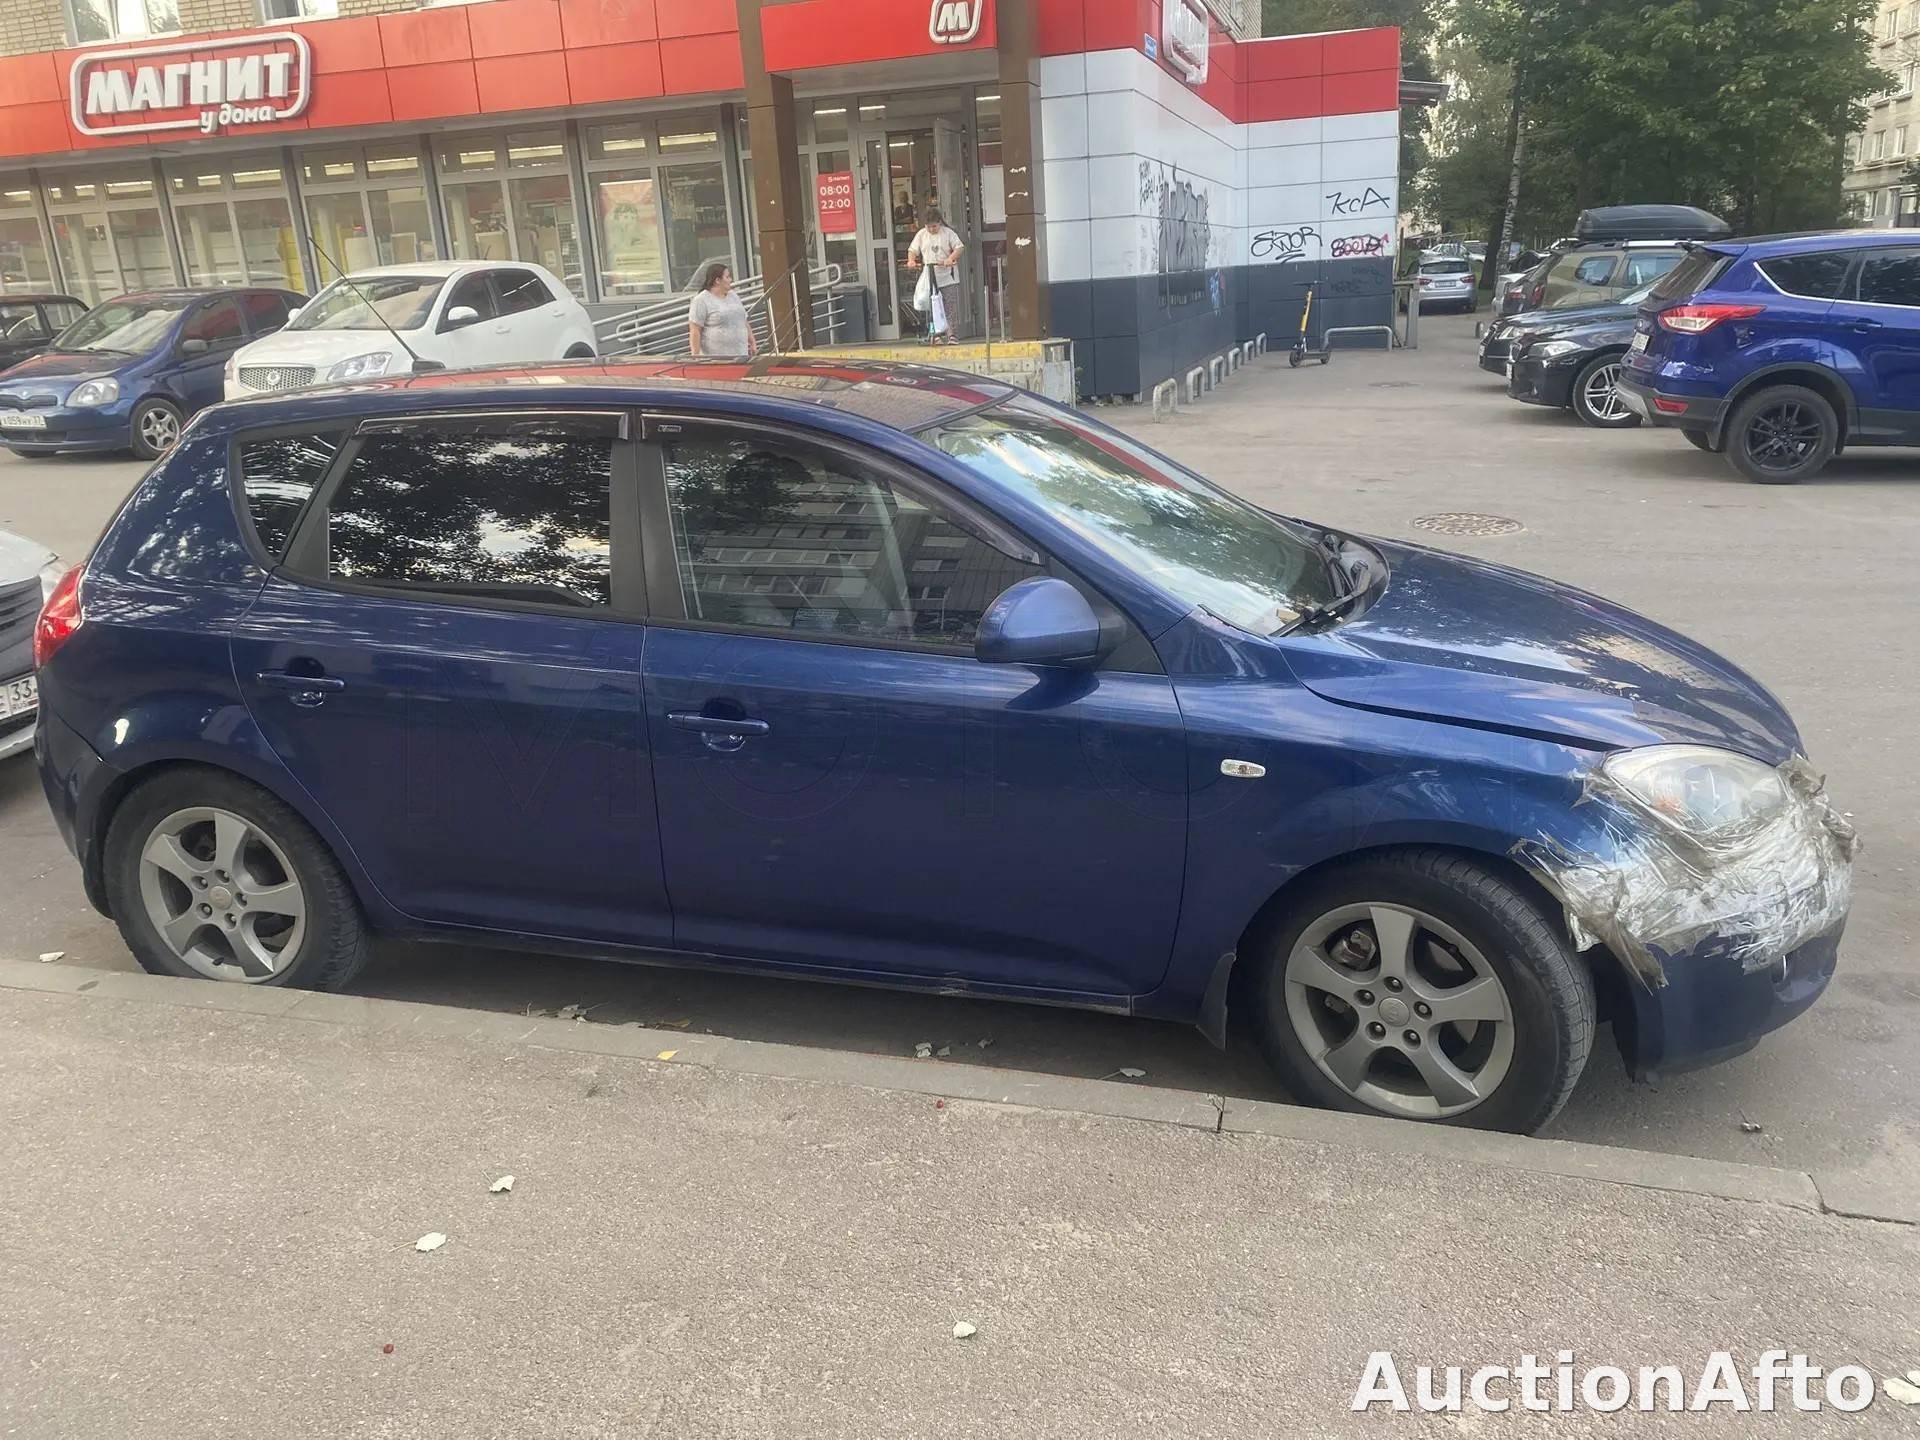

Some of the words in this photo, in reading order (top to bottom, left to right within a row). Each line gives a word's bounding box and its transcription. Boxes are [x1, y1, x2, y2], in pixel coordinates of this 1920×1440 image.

[86, 52, 294, 114] МАГНИТ
[218, 103, 276, 126] дома
[820, 185, 850, 196] 08:00
[821, 198, 851, 209] 22:00
